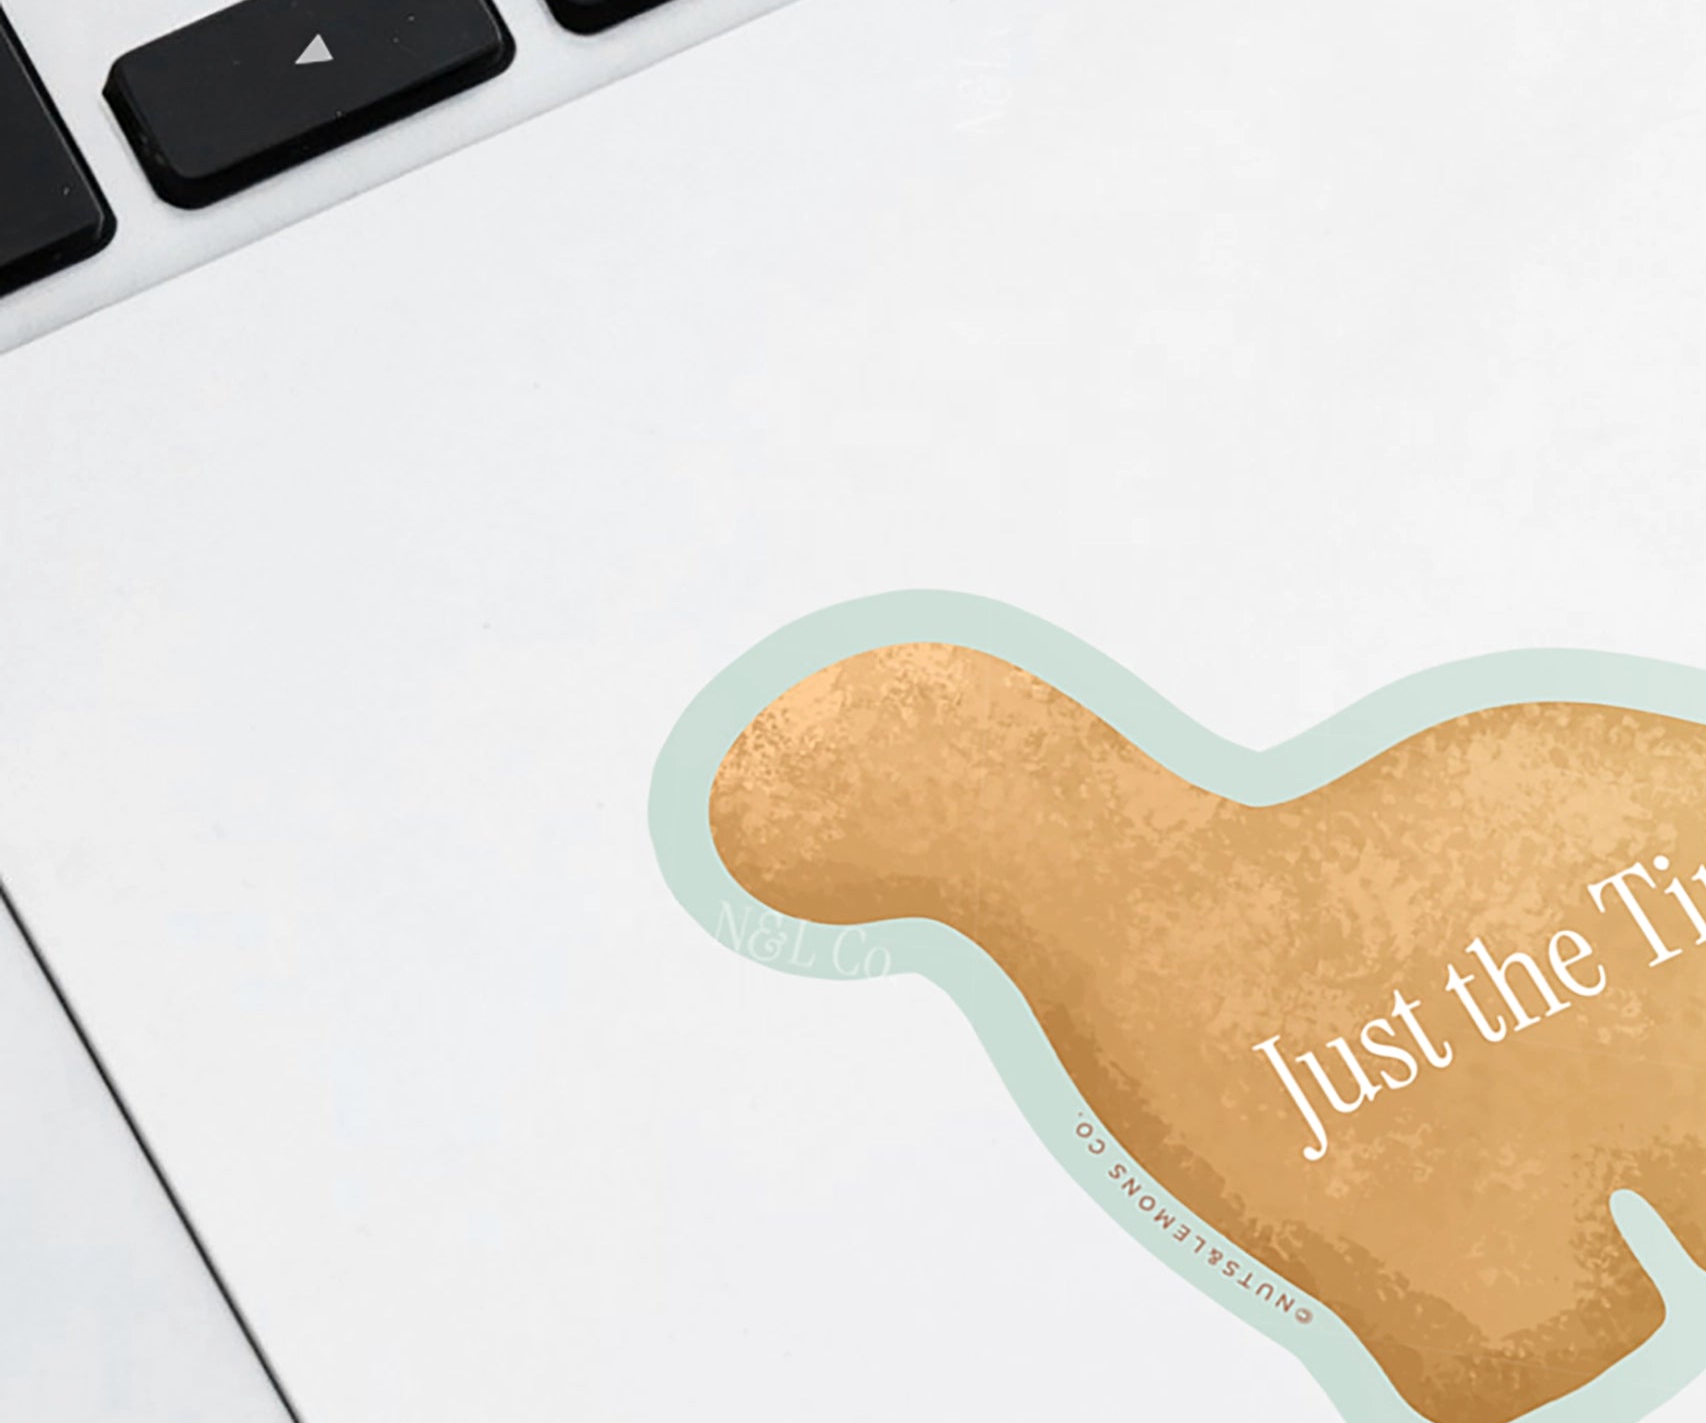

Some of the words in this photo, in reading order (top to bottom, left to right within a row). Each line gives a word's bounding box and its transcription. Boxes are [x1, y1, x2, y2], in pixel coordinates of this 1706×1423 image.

[1253, 989, 1454, 1162] Just
[1445, 929, 1607, 1043] the
[1075, 1111, 1106, 1155] CO.
